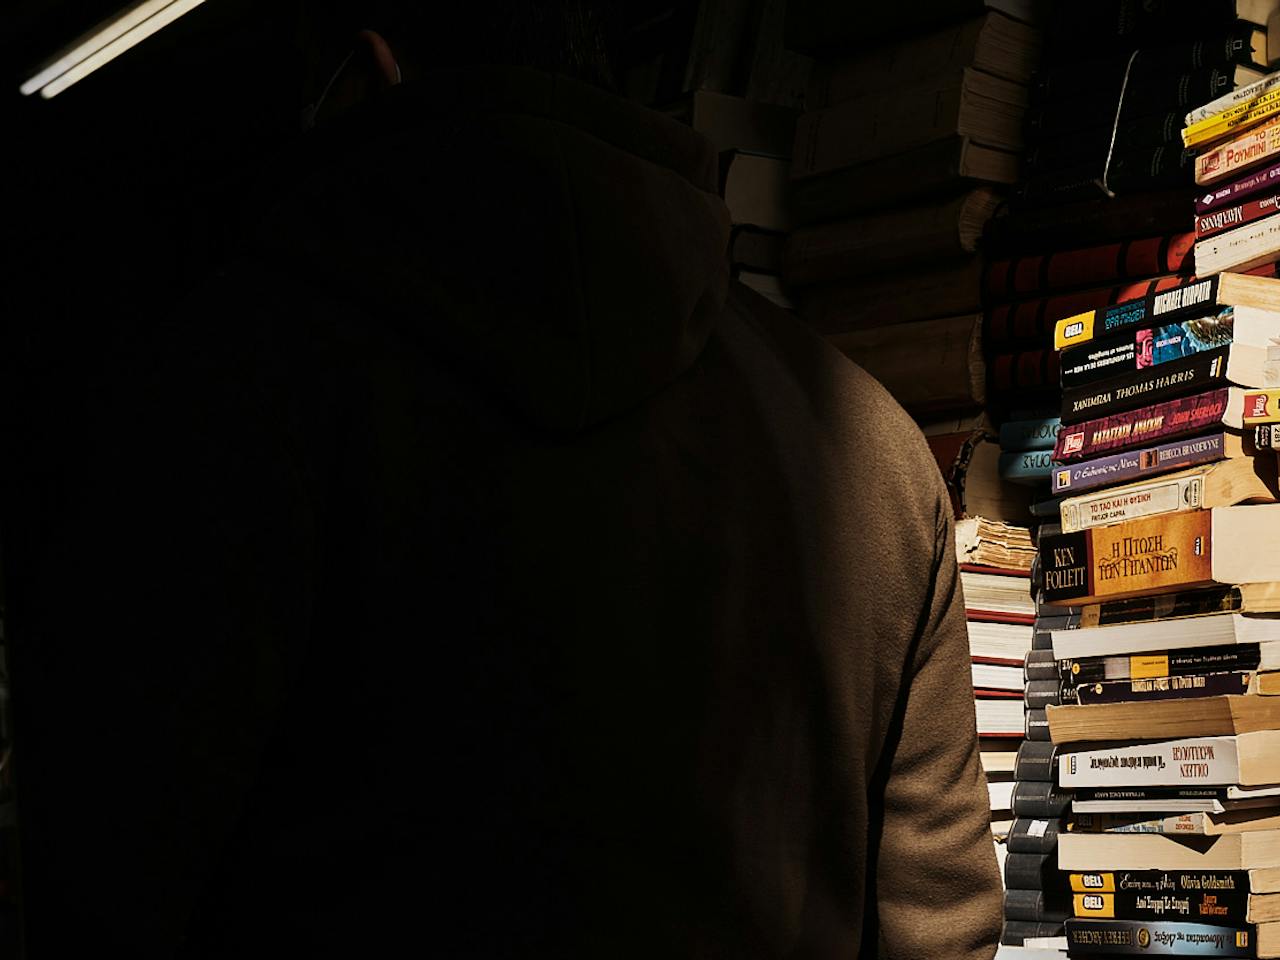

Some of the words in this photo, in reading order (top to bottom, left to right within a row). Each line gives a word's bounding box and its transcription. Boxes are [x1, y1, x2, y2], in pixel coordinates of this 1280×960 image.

[1225, 142, 1267, 168] ΡΟΥΜΠΙΝΙ
[1153, 289, 1182, 316] MICHAEL
[1116, 379, 1154, 400] THOMAS
[1155, 369, 1195, 389] HARRIS
[1053, 548, 1075, 567] KEN
[1046, 567, 1086, 591] FOLLETT
[1180, 875, 1200, 888] Olivia
[1083, 896, 1103, 909] BELL
